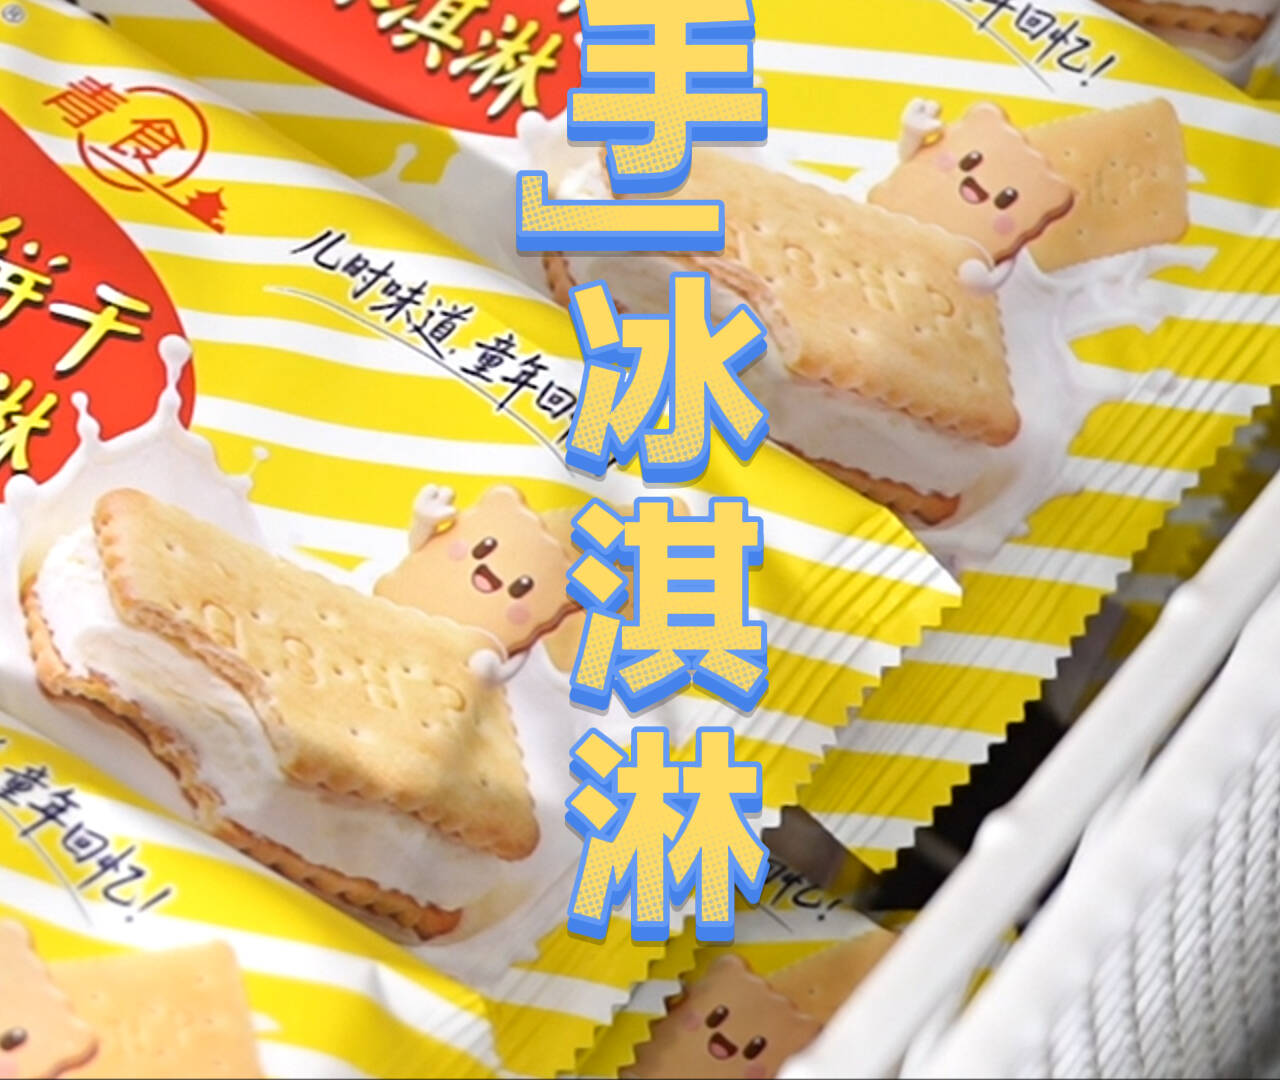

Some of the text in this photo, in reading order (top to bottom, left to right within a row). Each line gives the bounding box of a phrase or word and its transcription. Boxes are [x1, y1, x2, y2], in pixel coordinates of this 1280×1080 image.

[42, 75, 187, 176] 青食
[290, 230, 582, 447] 儿时味道，童年回
